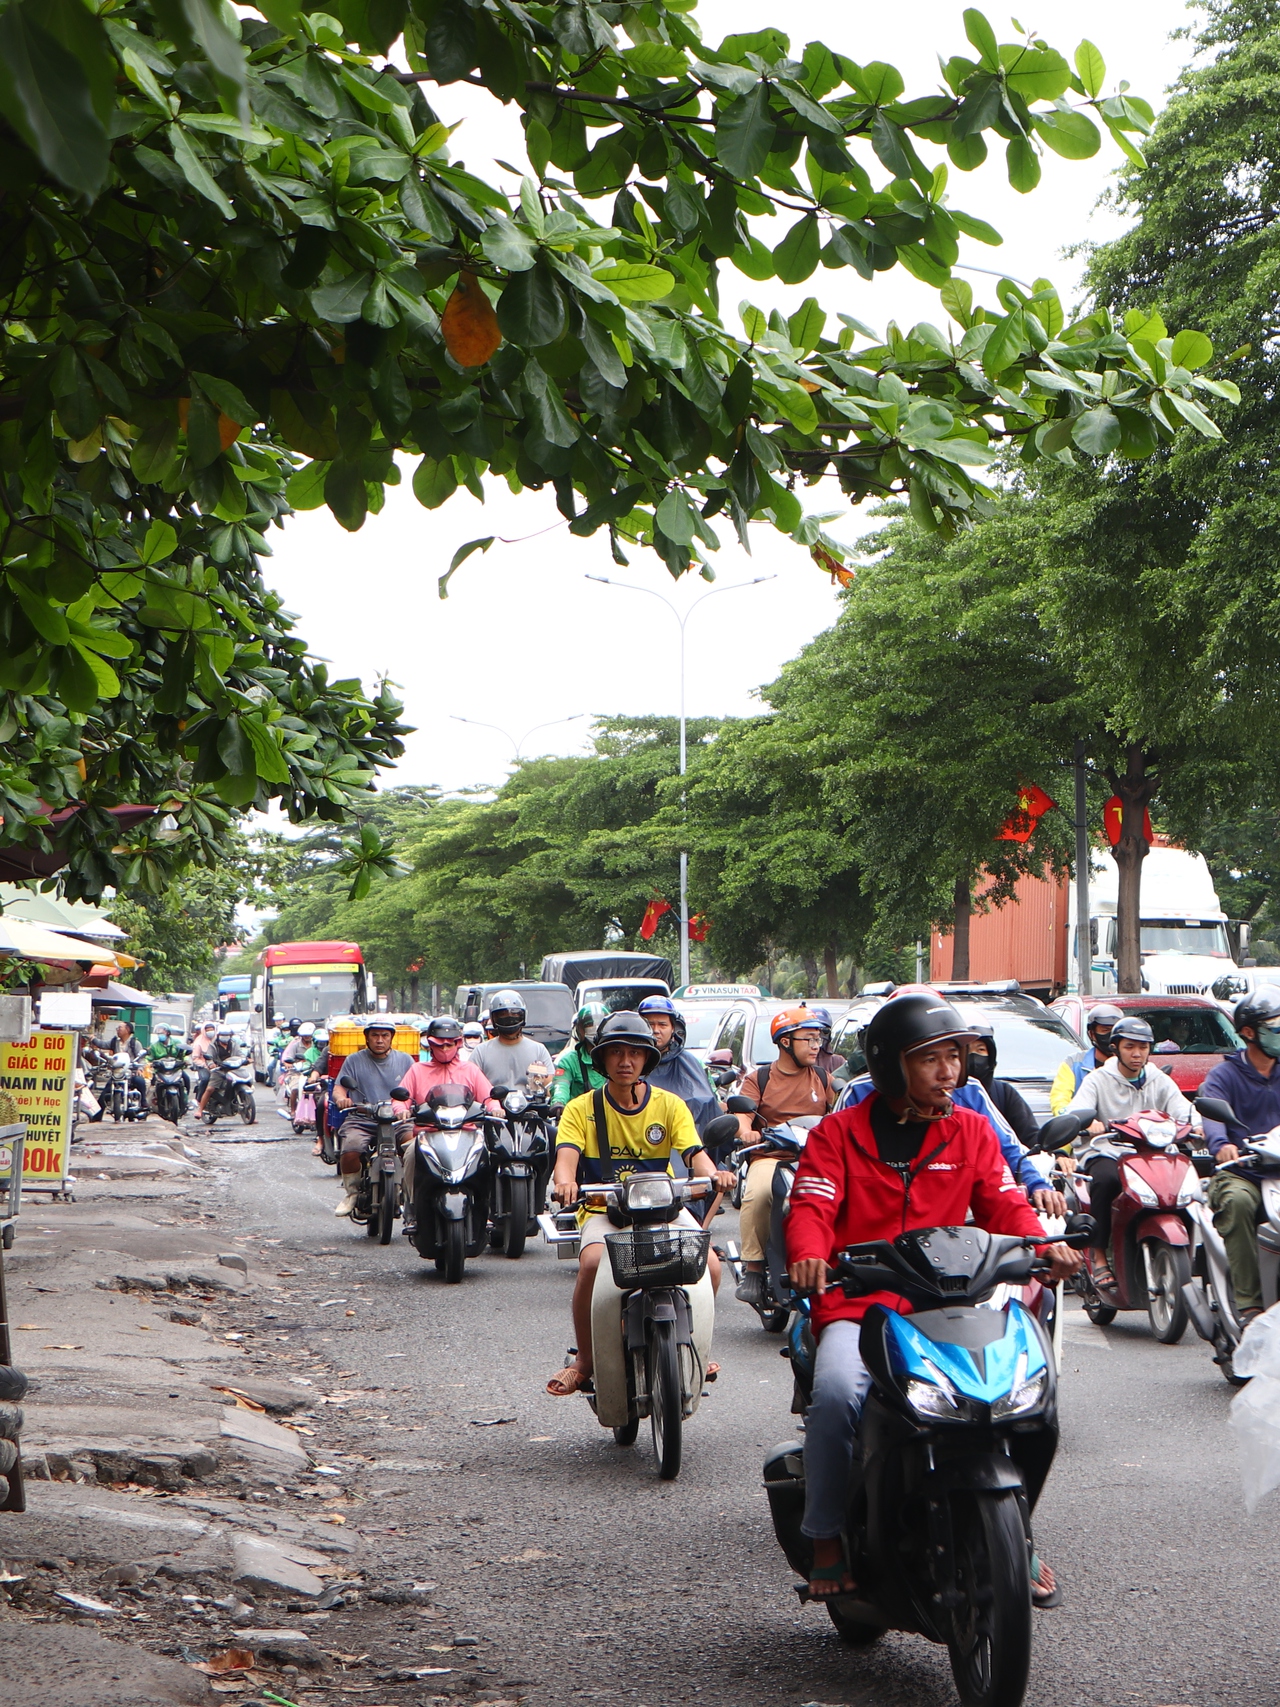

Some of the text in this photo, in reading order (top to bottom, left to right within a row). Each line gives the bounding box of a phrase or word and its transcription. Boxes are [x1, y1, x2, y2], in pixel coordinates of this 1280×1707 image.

[702, 987, 757, 995] VINASUN TAXI
[44, 1035, 65, 1050] GIÓ
[8, 1054, 66, 1071] GIÁC HƠI
[1, 1076, 66, 1091] NAM NỮ
[36, 1096, 41, 1106] Y
[43, 1097, 61, 1108] Học
[610, 1146, 642, 1158] PAU
